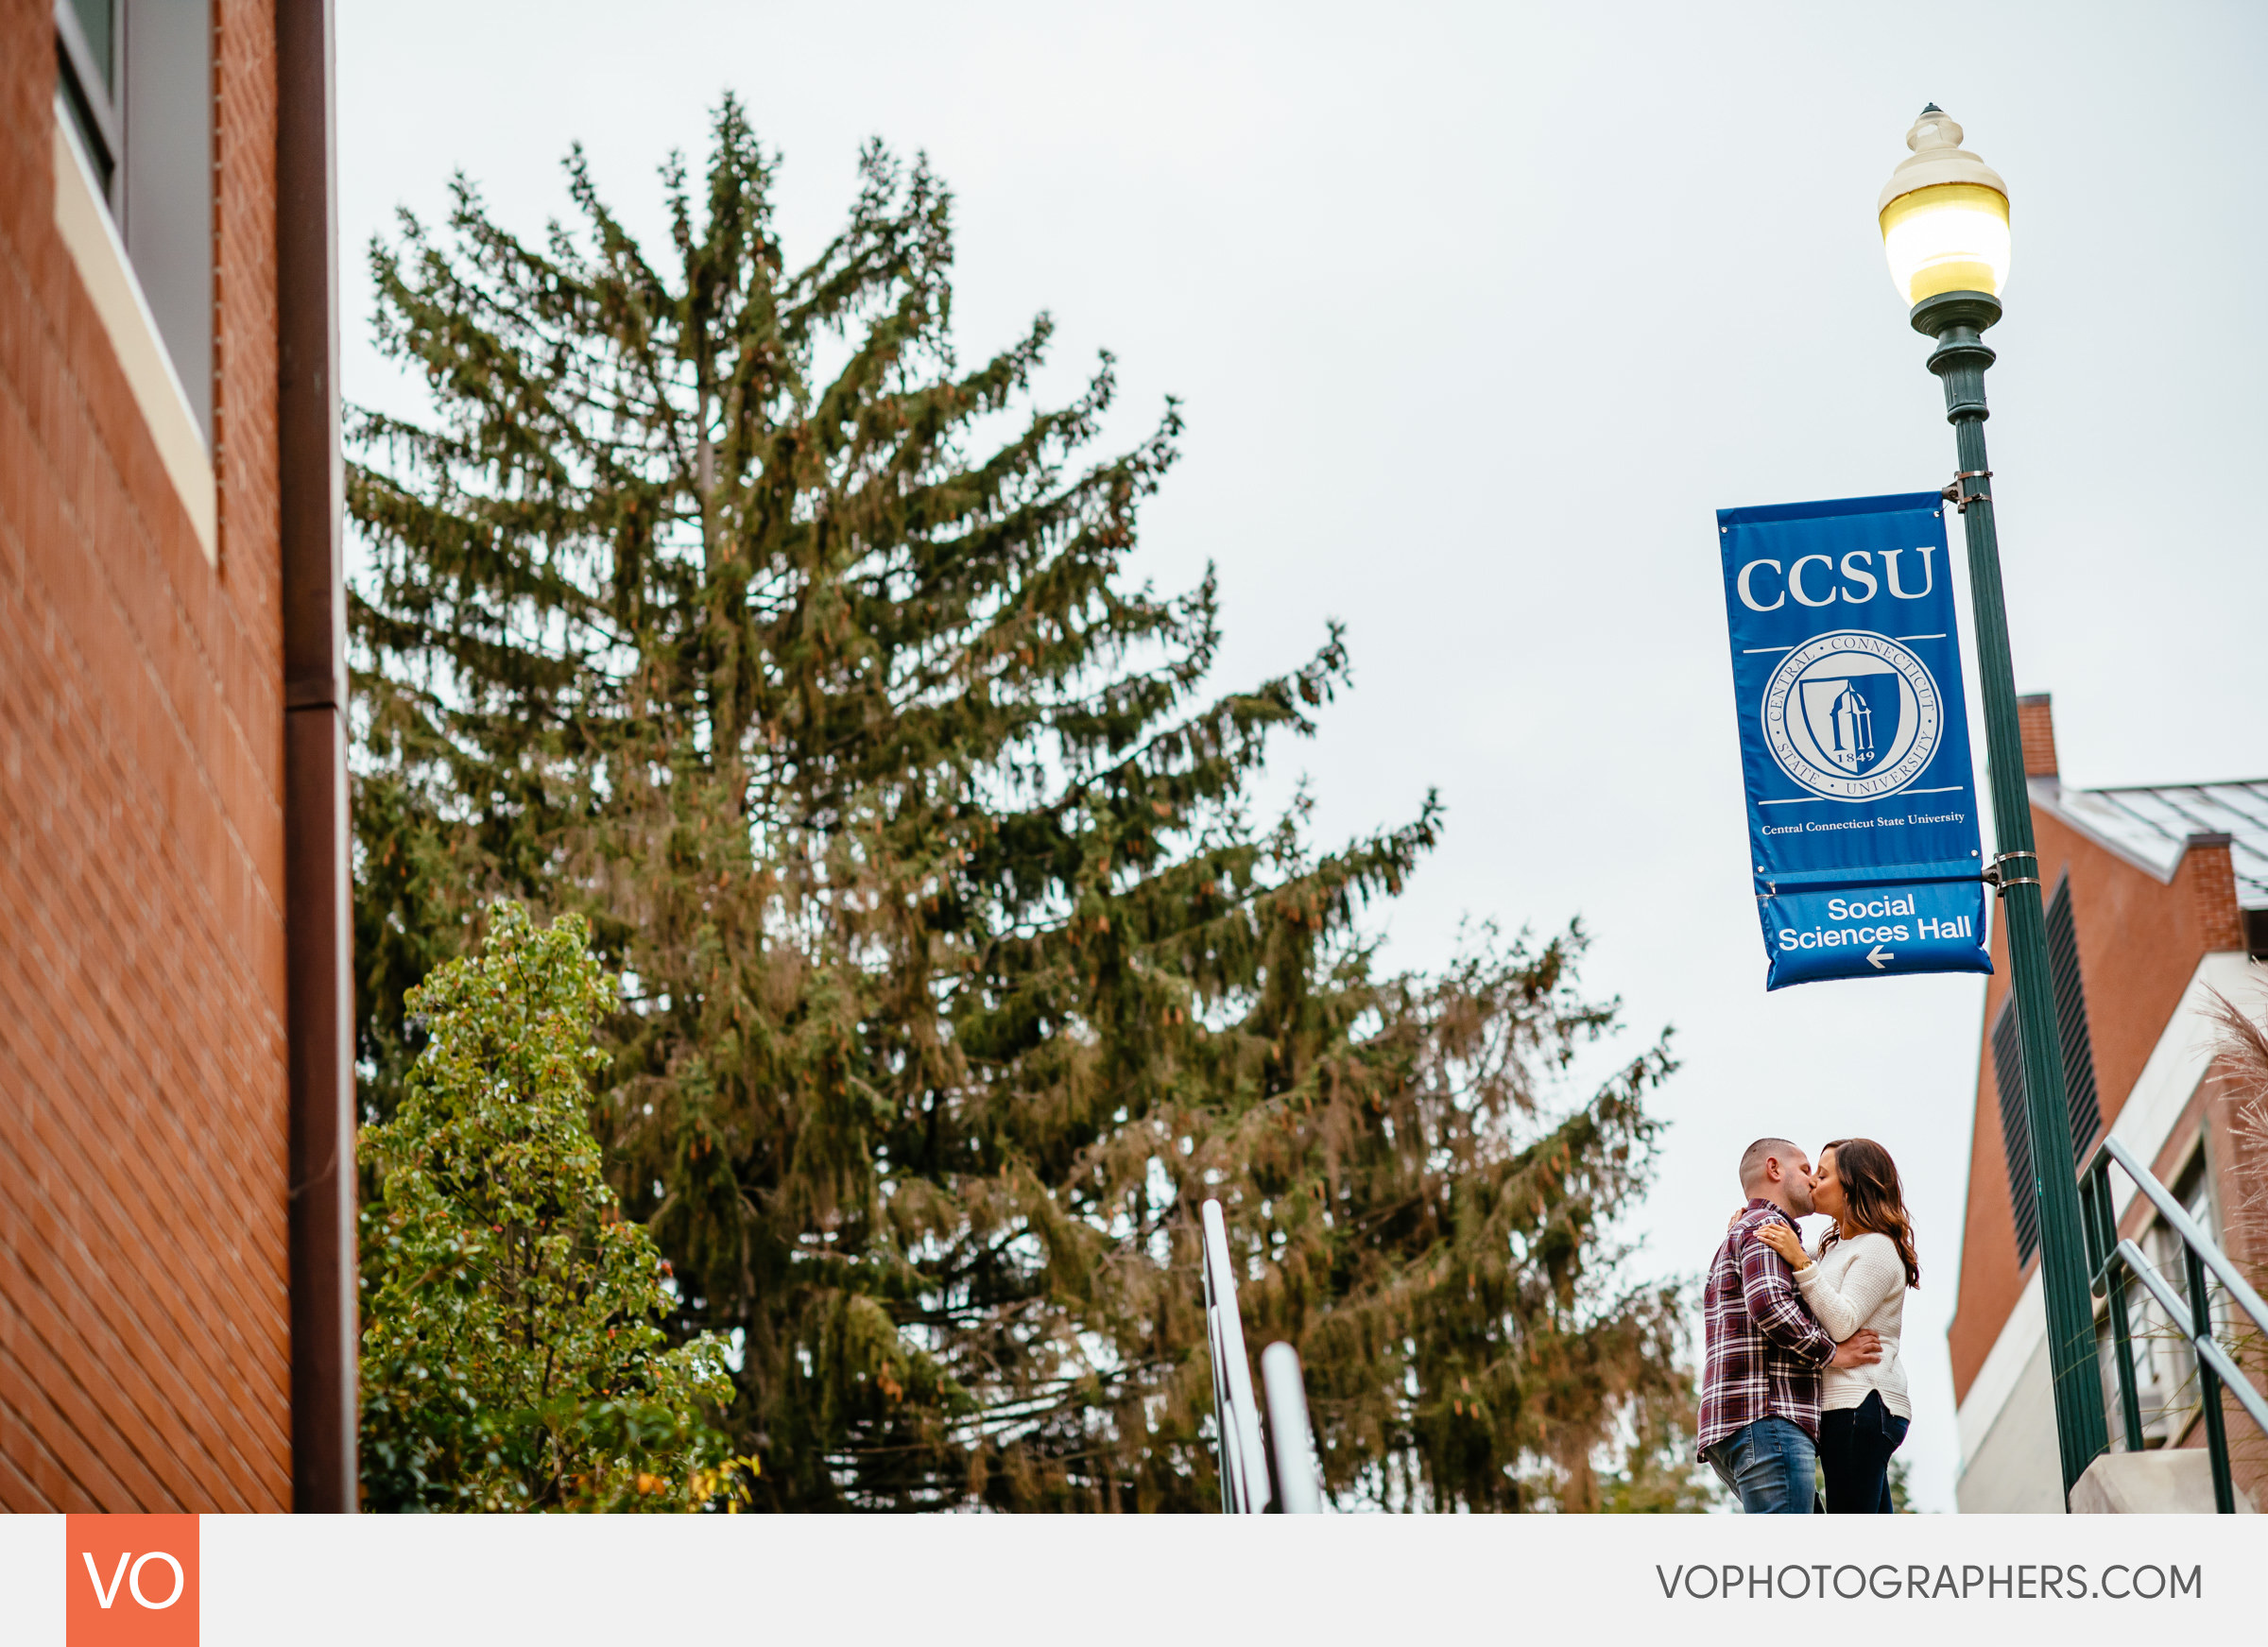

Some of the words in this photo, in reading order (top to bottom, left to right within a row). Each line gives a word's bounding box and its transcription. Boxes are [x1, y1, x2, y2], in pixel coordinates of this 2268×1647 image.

[1737, 546, 1936, 612] CCSU
[1769, 650, 1815, 722] CENTRAL
[1830, 637, 1934, 712] CONNECTICUT
[1777, 743, 1820, 785] STATE
[1847, 730, 1933, 795] UNIVERSITY
[1837, 751, 1875, 763] 1849
[1761, 823, 1803, 835] Central
[1806, 819, 1875, 832] Connecticut
[1877, 816, 1905, 828] State
[1907, 812, 1965, 825] University
[1828, 894, 1916, 920] Social
[1778, 926, 1909, 952] Sciences
[1917, 915, 1972, 940] Hall
